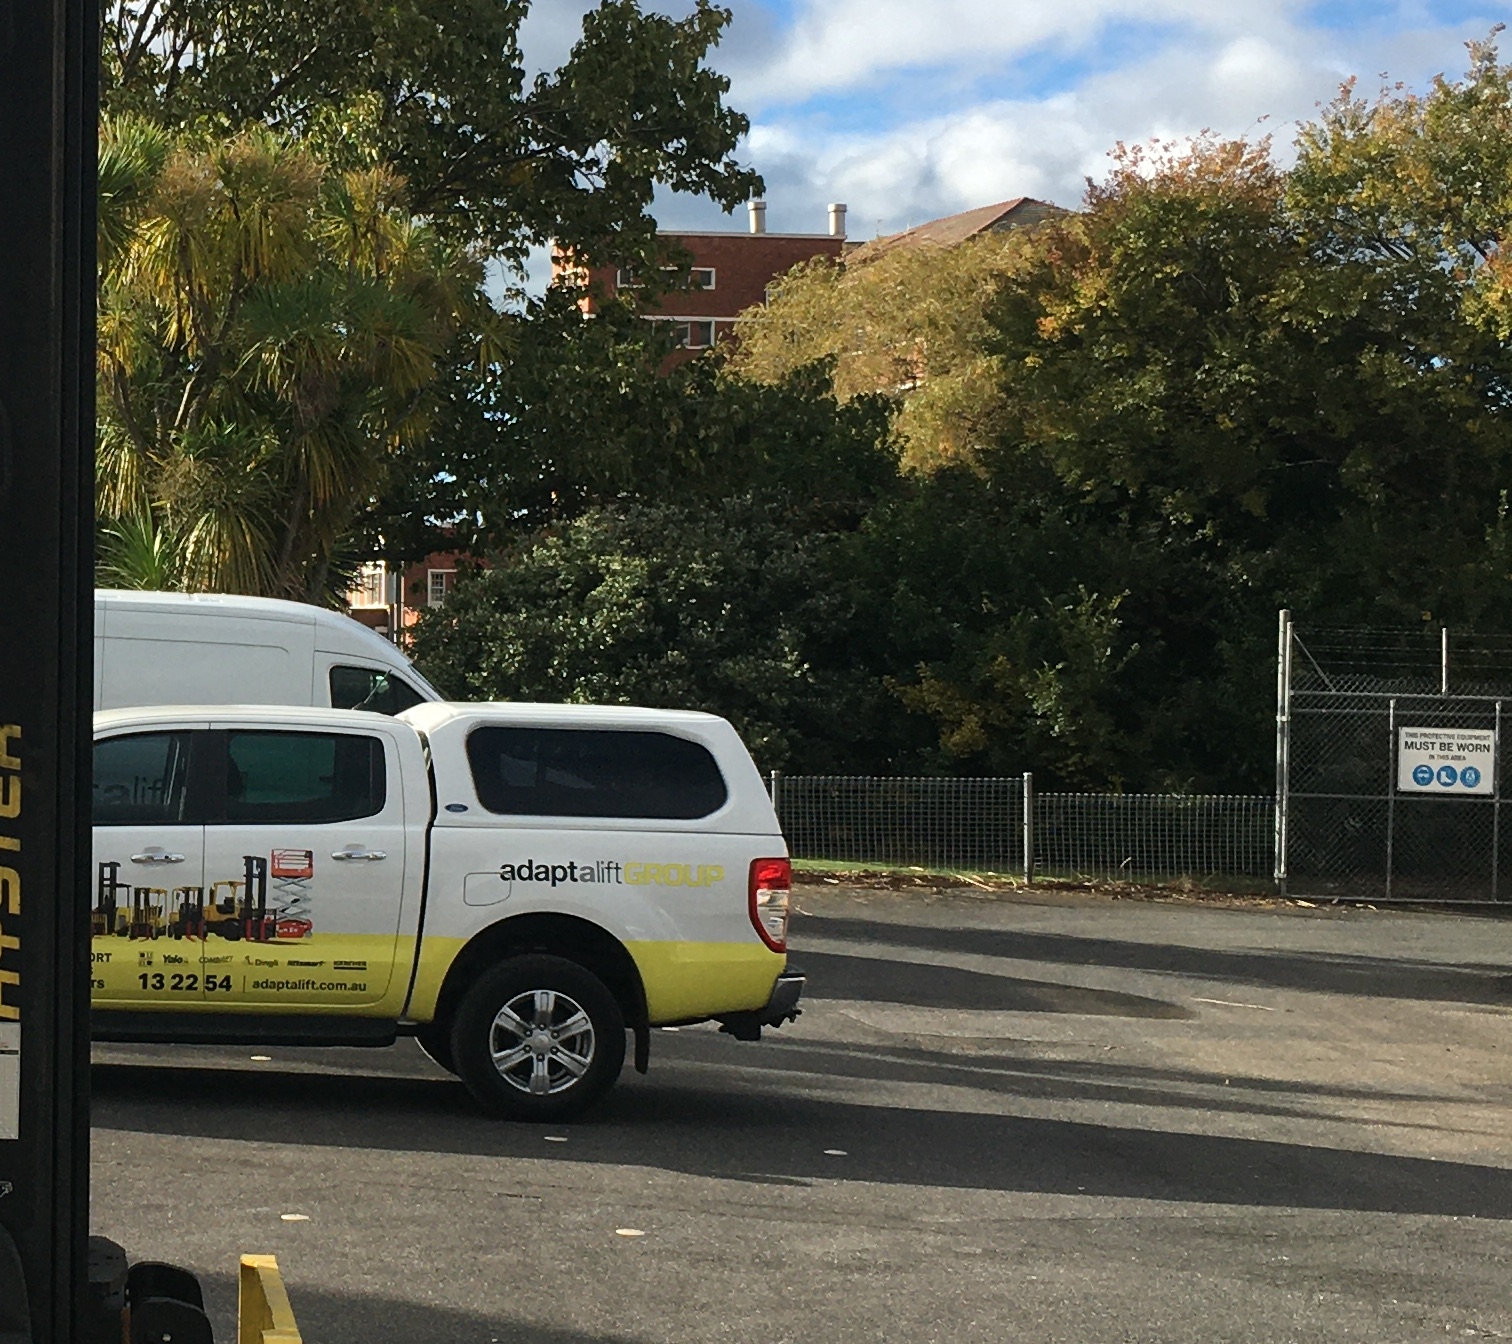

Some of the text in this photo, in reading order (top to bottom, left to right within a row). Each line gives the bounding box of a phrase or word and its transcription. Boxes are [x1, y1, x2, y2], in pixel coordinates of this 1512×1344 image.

[1404, 741, 1491, 753] MUST BE WORN
[138, 973, 232, 992] 13 22 54
[252, 975, 367, 992] adaptalift.com.au
